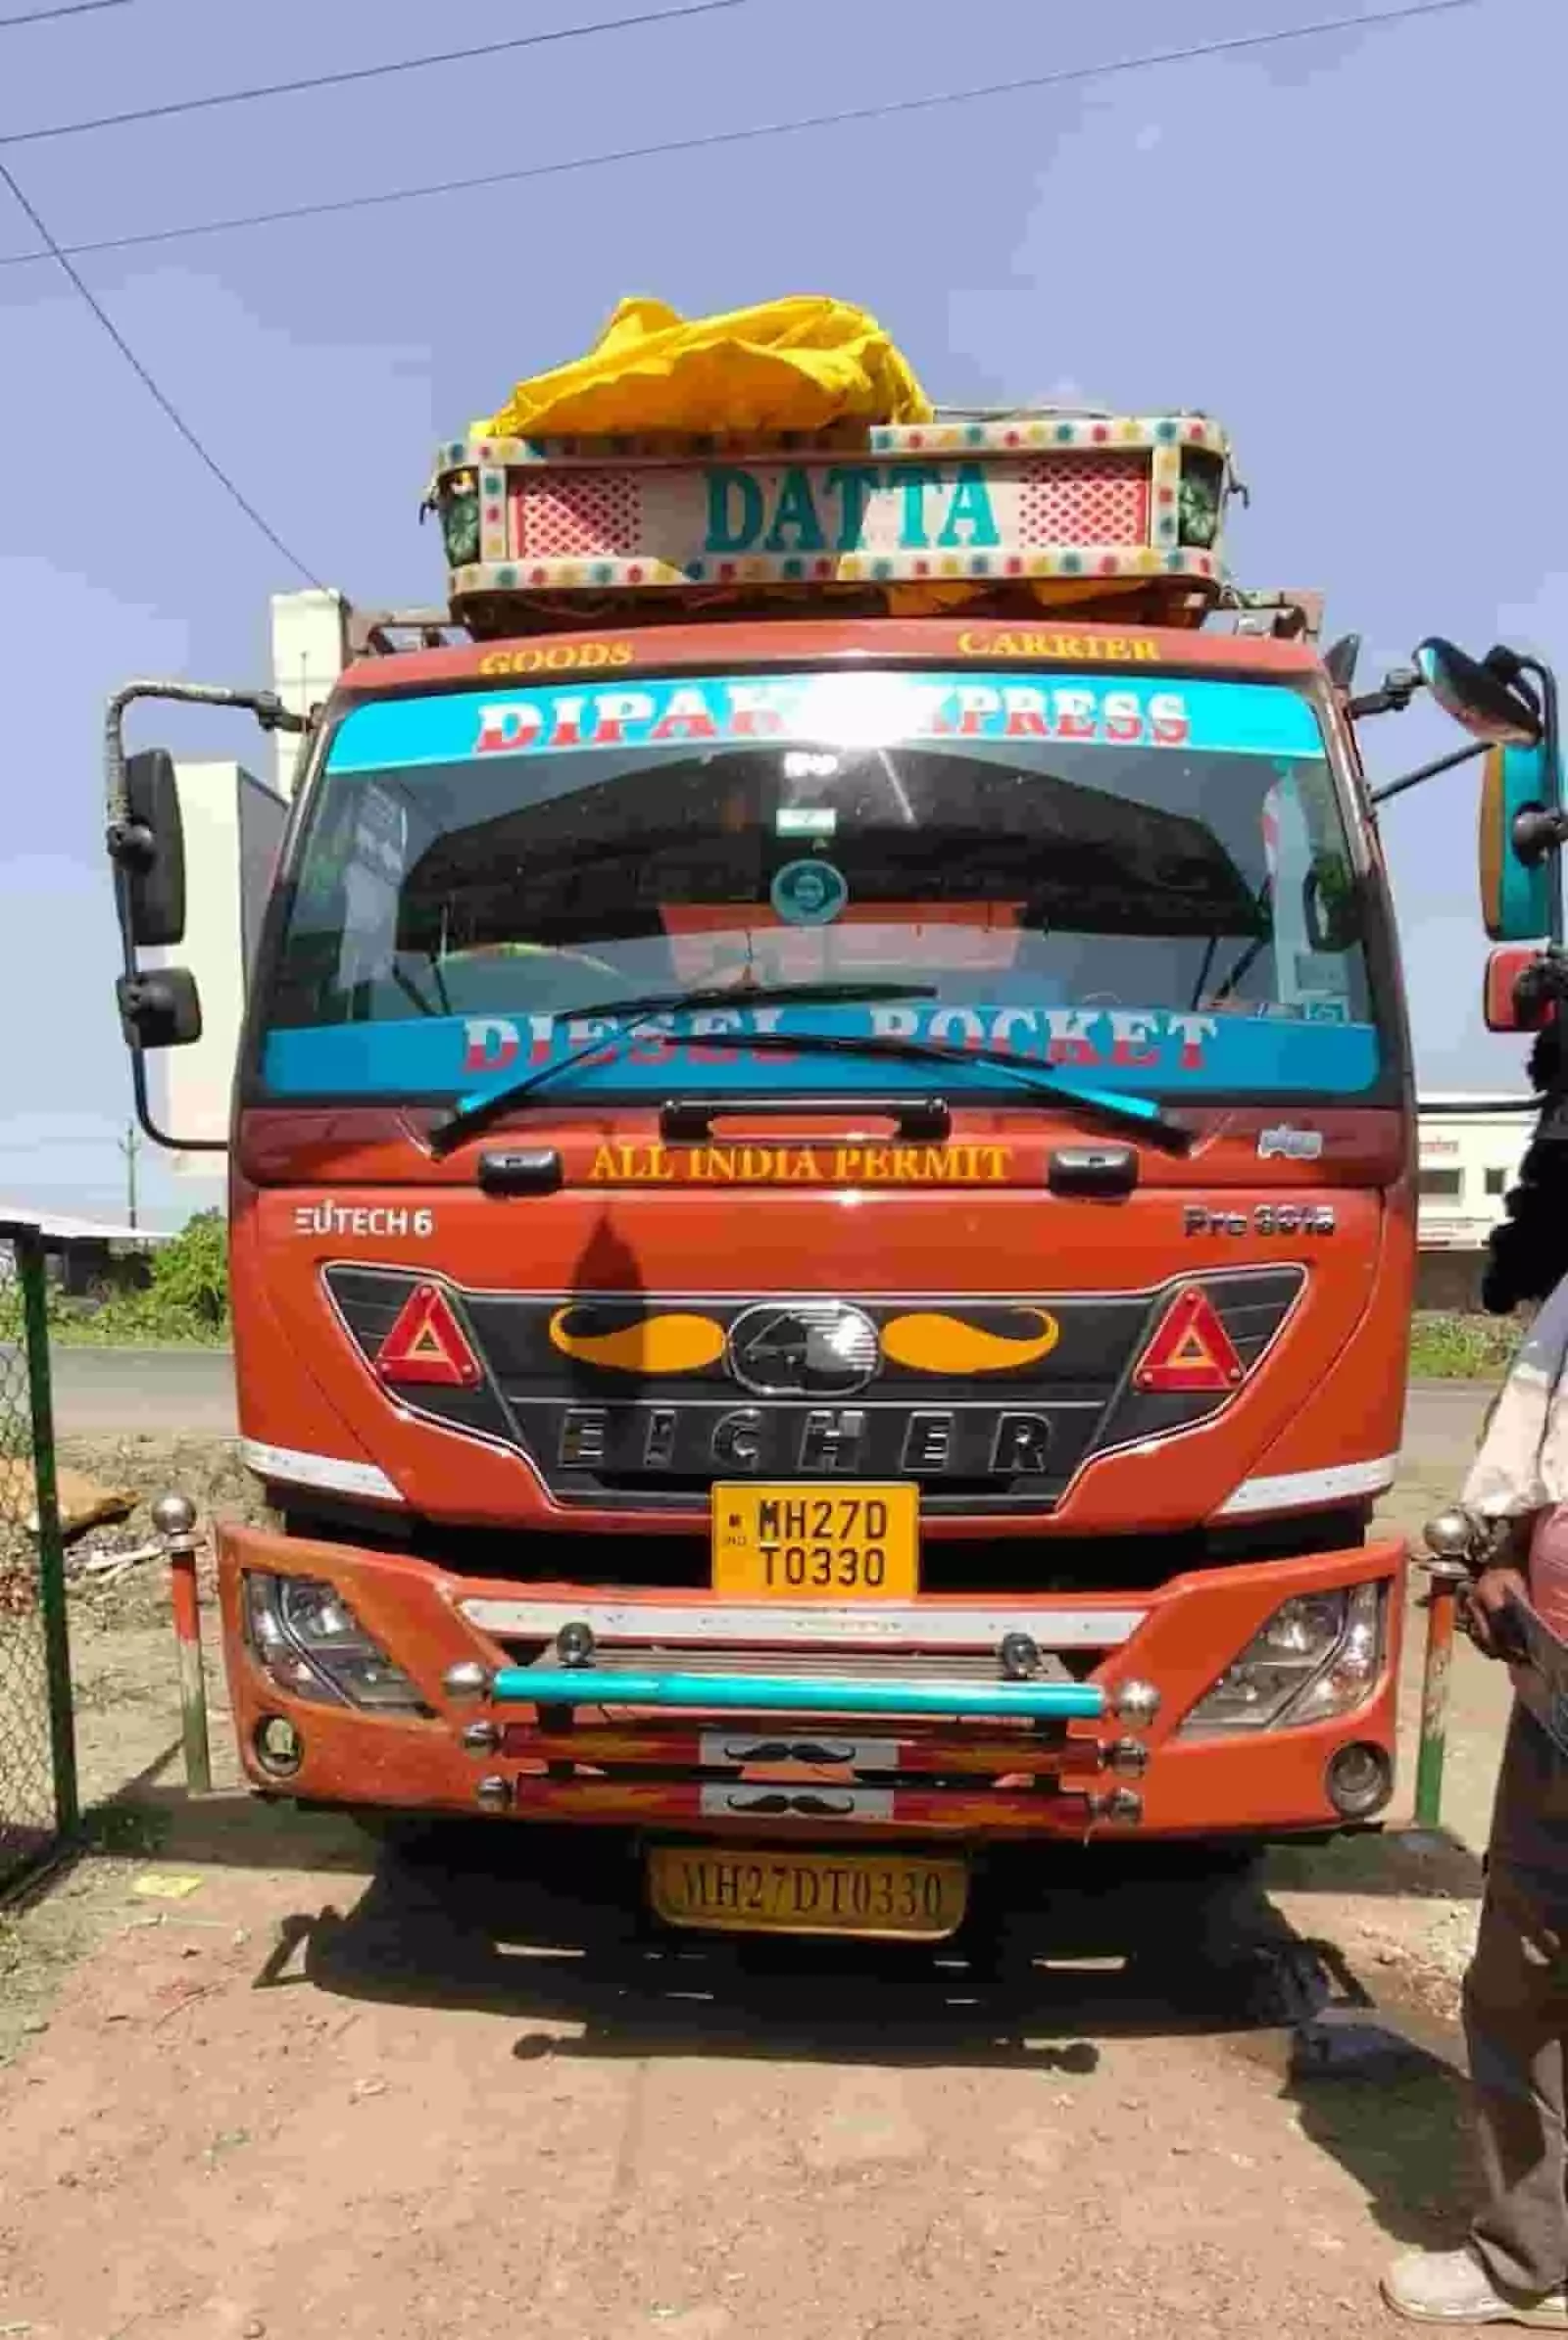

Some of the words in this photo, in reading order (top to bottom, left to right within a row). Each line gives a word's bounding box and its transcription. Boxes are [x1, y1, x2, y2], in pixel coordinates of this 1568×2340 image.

[703, 465, 1002, 553] DATTA
[477, 641, 635, 676] GOODS
[956, 631, 1161, 661] CARRIER
[862, 682, 1191, 747] PRESS
[591, 1144, 675, 1179] ALL
[689, 1145, 819, 1180] INDIA
[833, 1145, 1013, 1182] PERMIT
[413, 1206, 434, 1239] 6
[557, 1407, 1054, 1473] EICHER
[759, 1499, 888, 1541] MH27D
[758, 1545, 886, 1587] T0330
[682, 1862, 943, 1918] MH27DT0330
